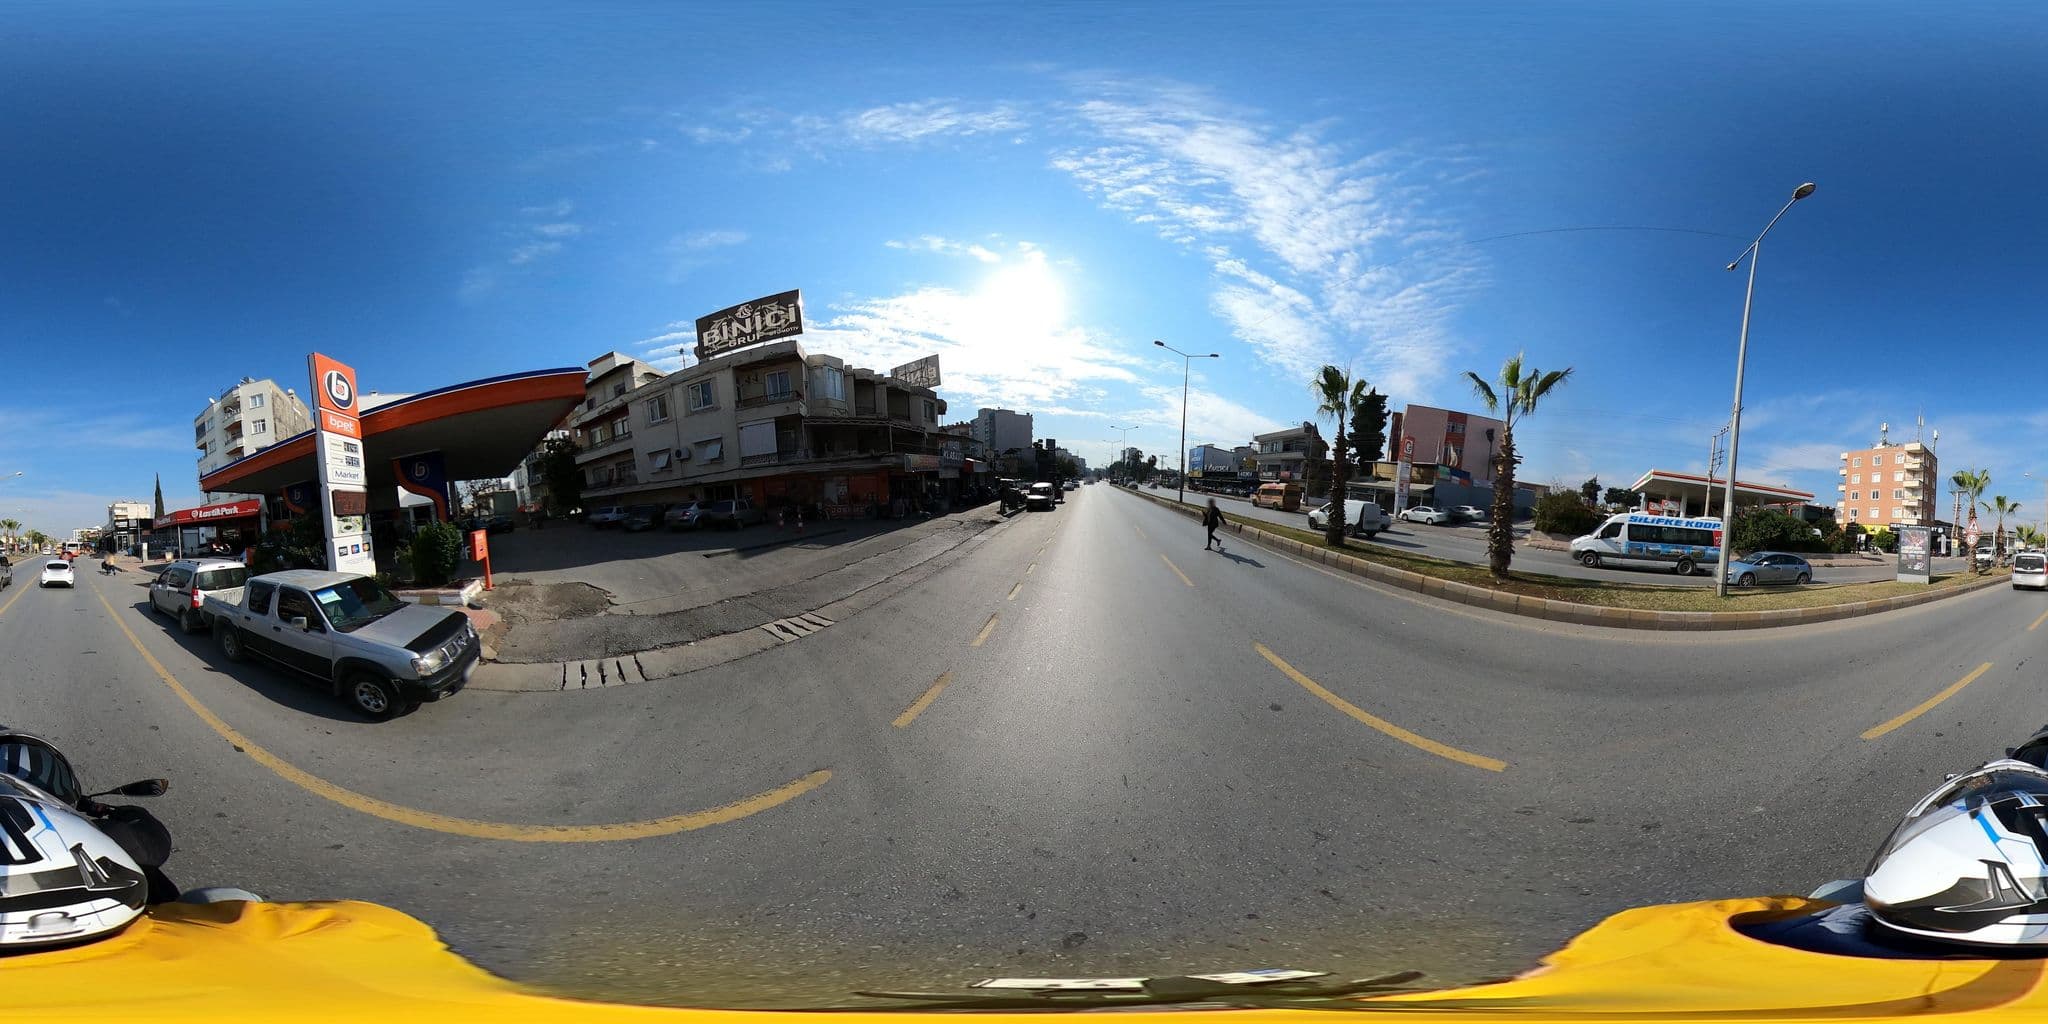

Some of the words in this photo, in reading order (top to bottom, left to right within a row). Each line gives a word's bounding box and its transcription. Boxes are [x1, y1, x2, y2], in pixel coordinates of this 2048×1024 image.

[329, 415, 354, 431] bpet
[335, 470, 360, 480] Market
[1685, 520, 1721, 529] KOOP
